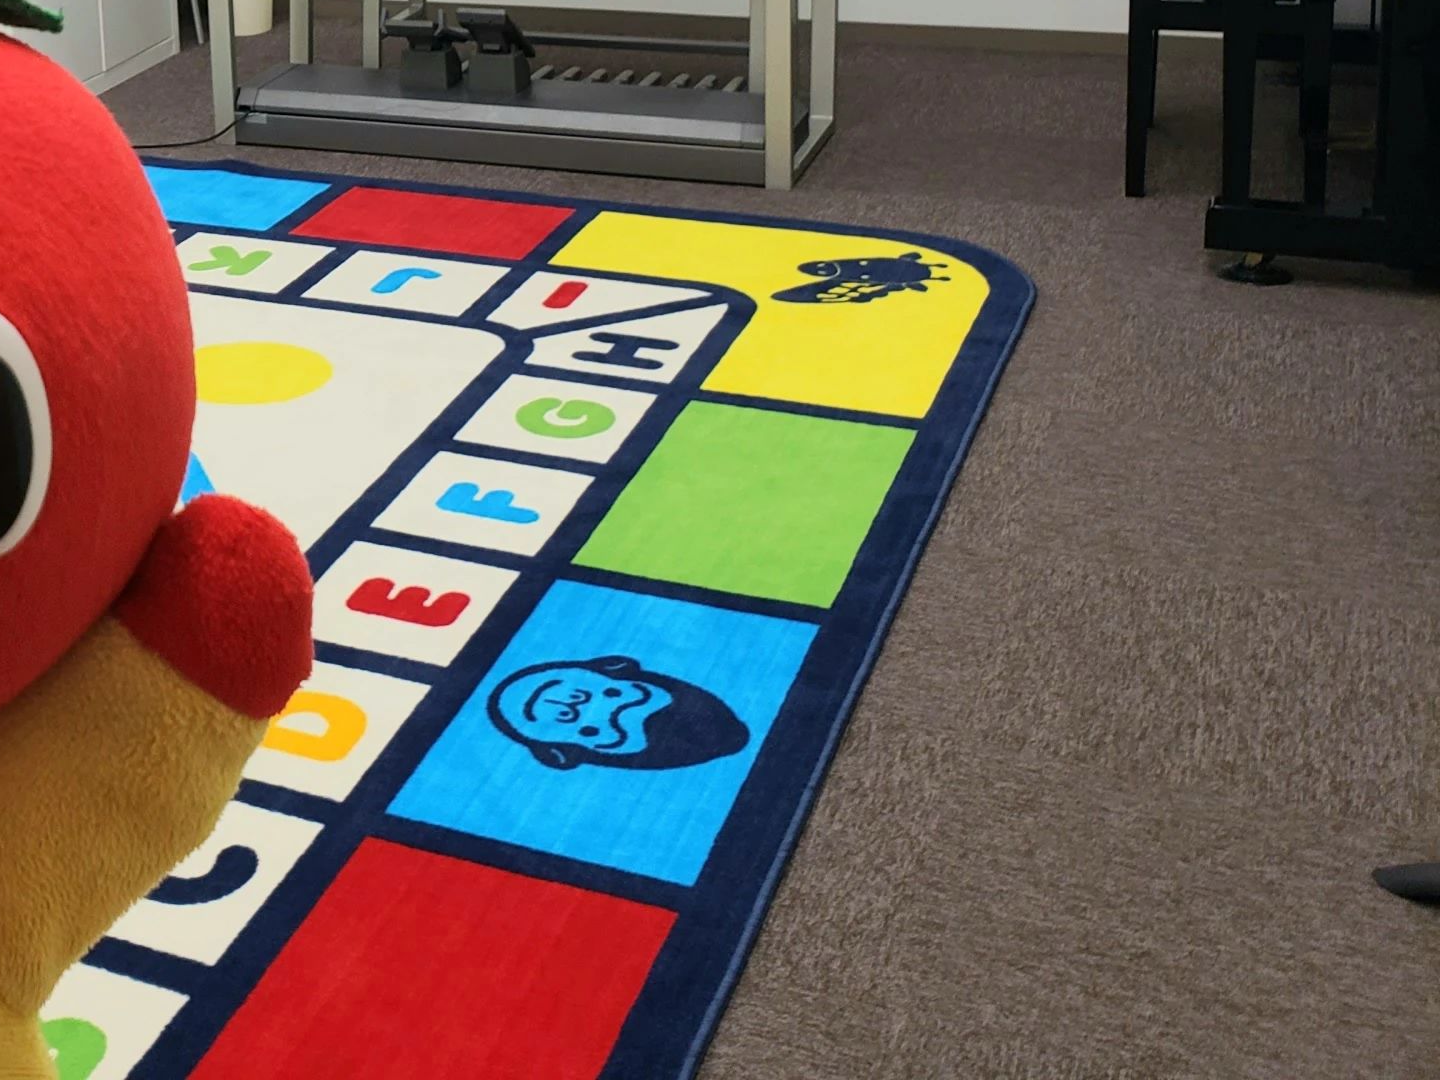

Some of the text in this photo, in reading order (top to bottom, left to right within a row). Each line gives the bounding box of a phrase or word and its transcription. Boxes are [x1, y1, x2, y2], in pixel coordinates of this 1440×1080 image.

[186, 245, 274, 277] K
[371, 267, 443, 294] J
[571, 332, 681, 370] H
[514, 396, 617, 440] G
[435, 482, 540, 524] F
[345, 577, 471, 628] E
[260, 690, 368, 763] D
